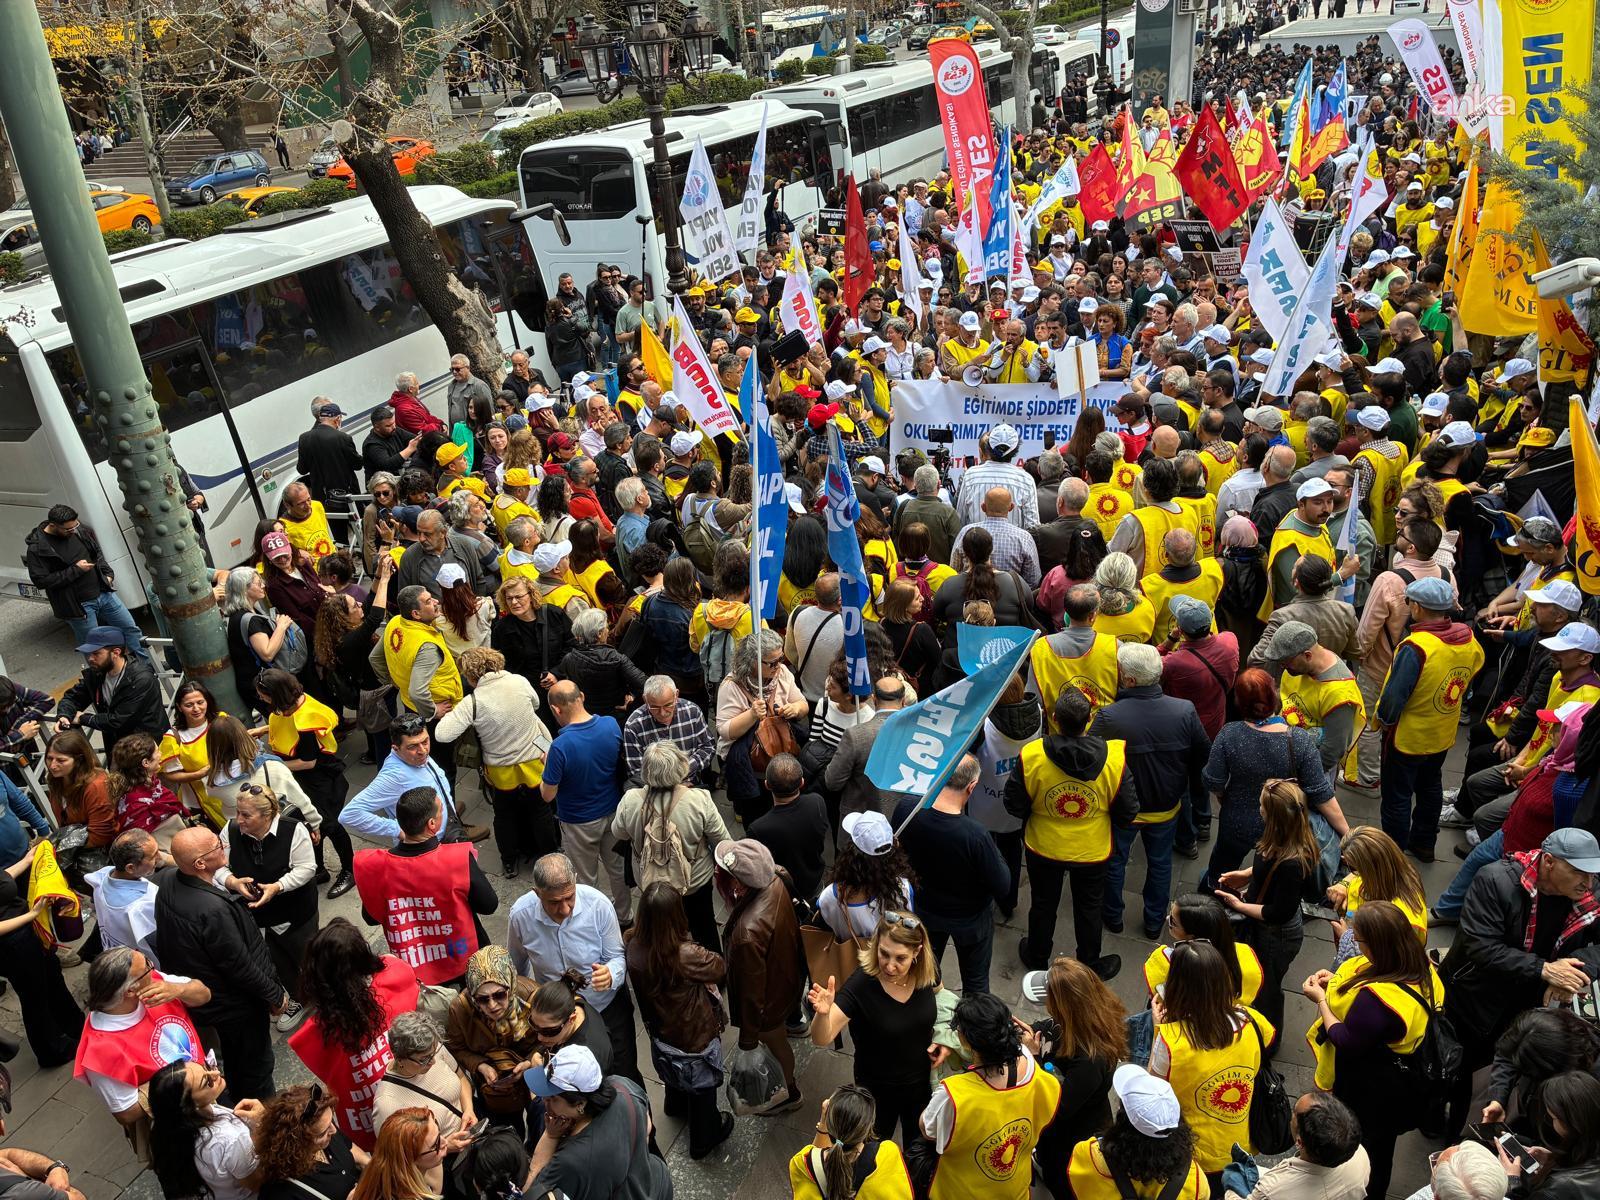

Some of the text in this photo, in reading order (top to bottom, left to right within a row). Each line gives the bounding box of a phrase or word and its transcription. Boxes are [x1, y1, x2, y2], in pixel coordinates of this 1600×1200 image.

[1514, 299, 1538, 315] SE
[964, 395, 1023, 417] EĞİTİMDE
[1027, 395, 1077, 421] ŞİDDETE
[267, 538, 285, 550] 46
[995, 757, 1017, 776] KE
[1048, 785, 1097, 803] EĞİTİM SEN
[388, 896, 435, 911] EMEK
[388, 910, 442, 927] EYLEM
[352, 1050, 394, 1084] EYLE
[1202, 1070, 1241, 1092] EĞİTİM
